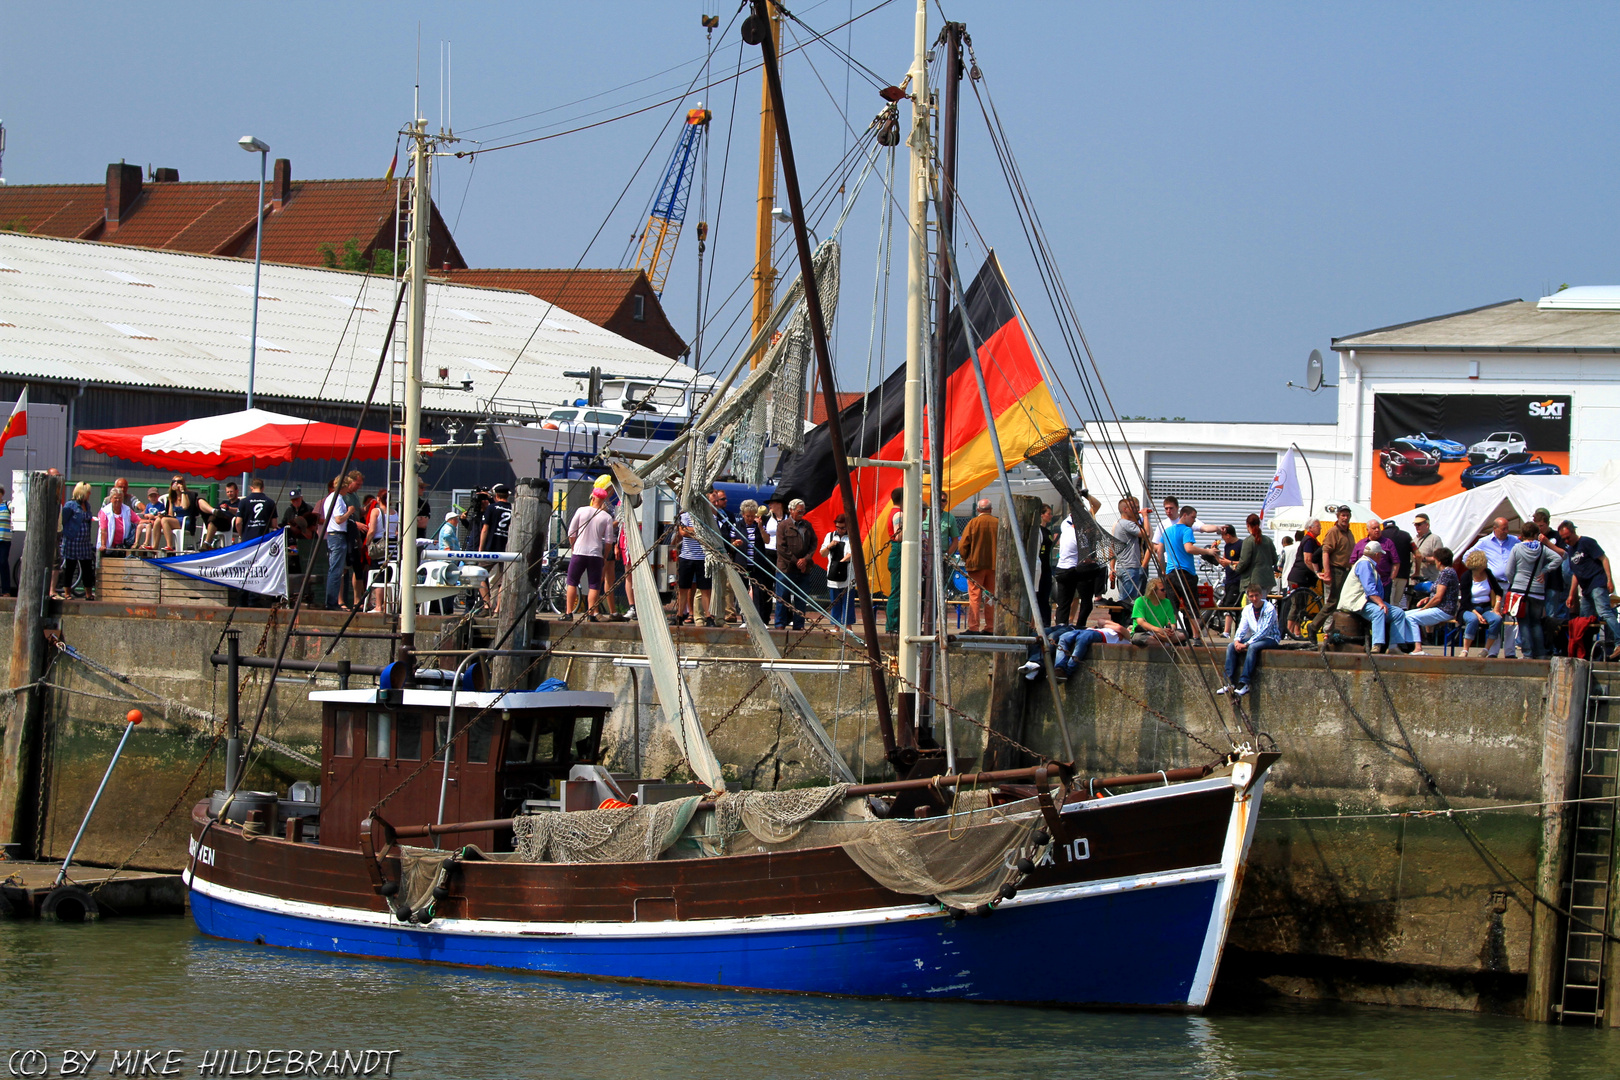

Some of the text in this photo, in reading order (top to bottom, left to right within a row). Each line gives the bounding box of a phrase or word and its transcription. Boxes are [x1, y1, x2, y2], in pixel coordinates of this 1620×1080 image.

[253, 502, 264, 519] 9
[498, 512, 511, 528] 2
[1062, 837, 1091, 863] 10
